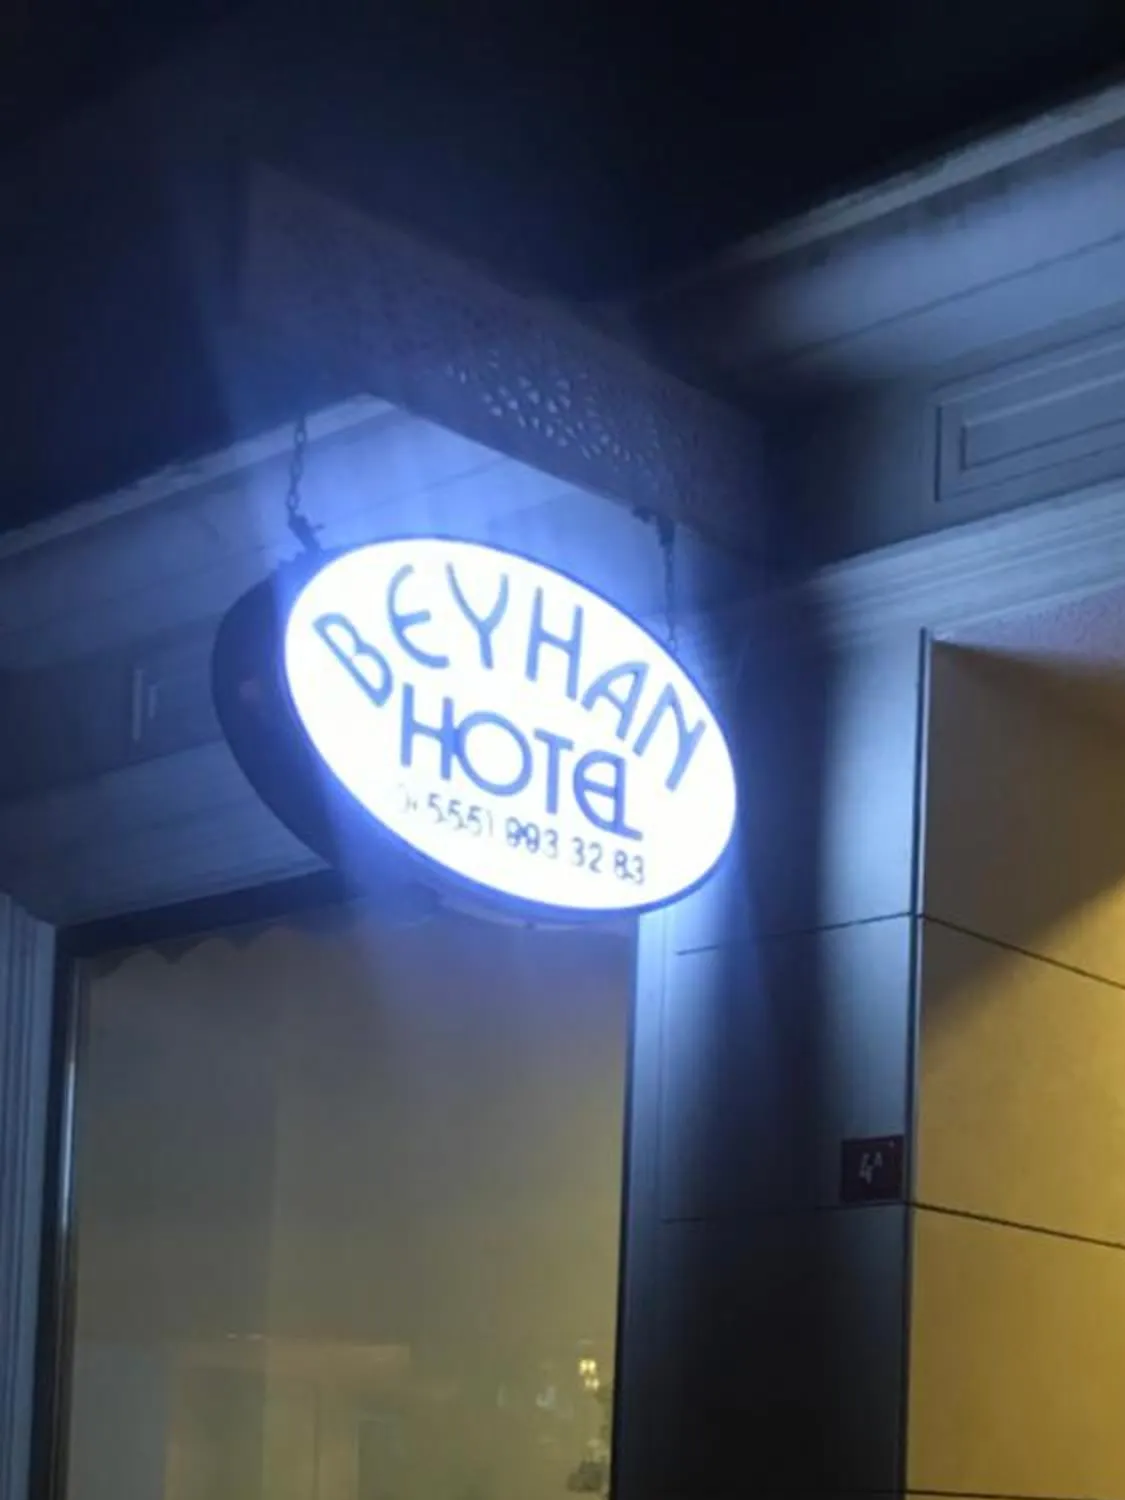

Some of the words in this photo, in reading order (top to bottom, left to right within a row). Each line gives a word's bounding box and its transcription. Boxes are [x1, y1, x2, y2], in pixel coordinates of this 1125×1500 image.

[313, 562, 706, 791] BEYHAN
[571, 836, 603, 872] 32
[614, 849, 646, 885] 83
